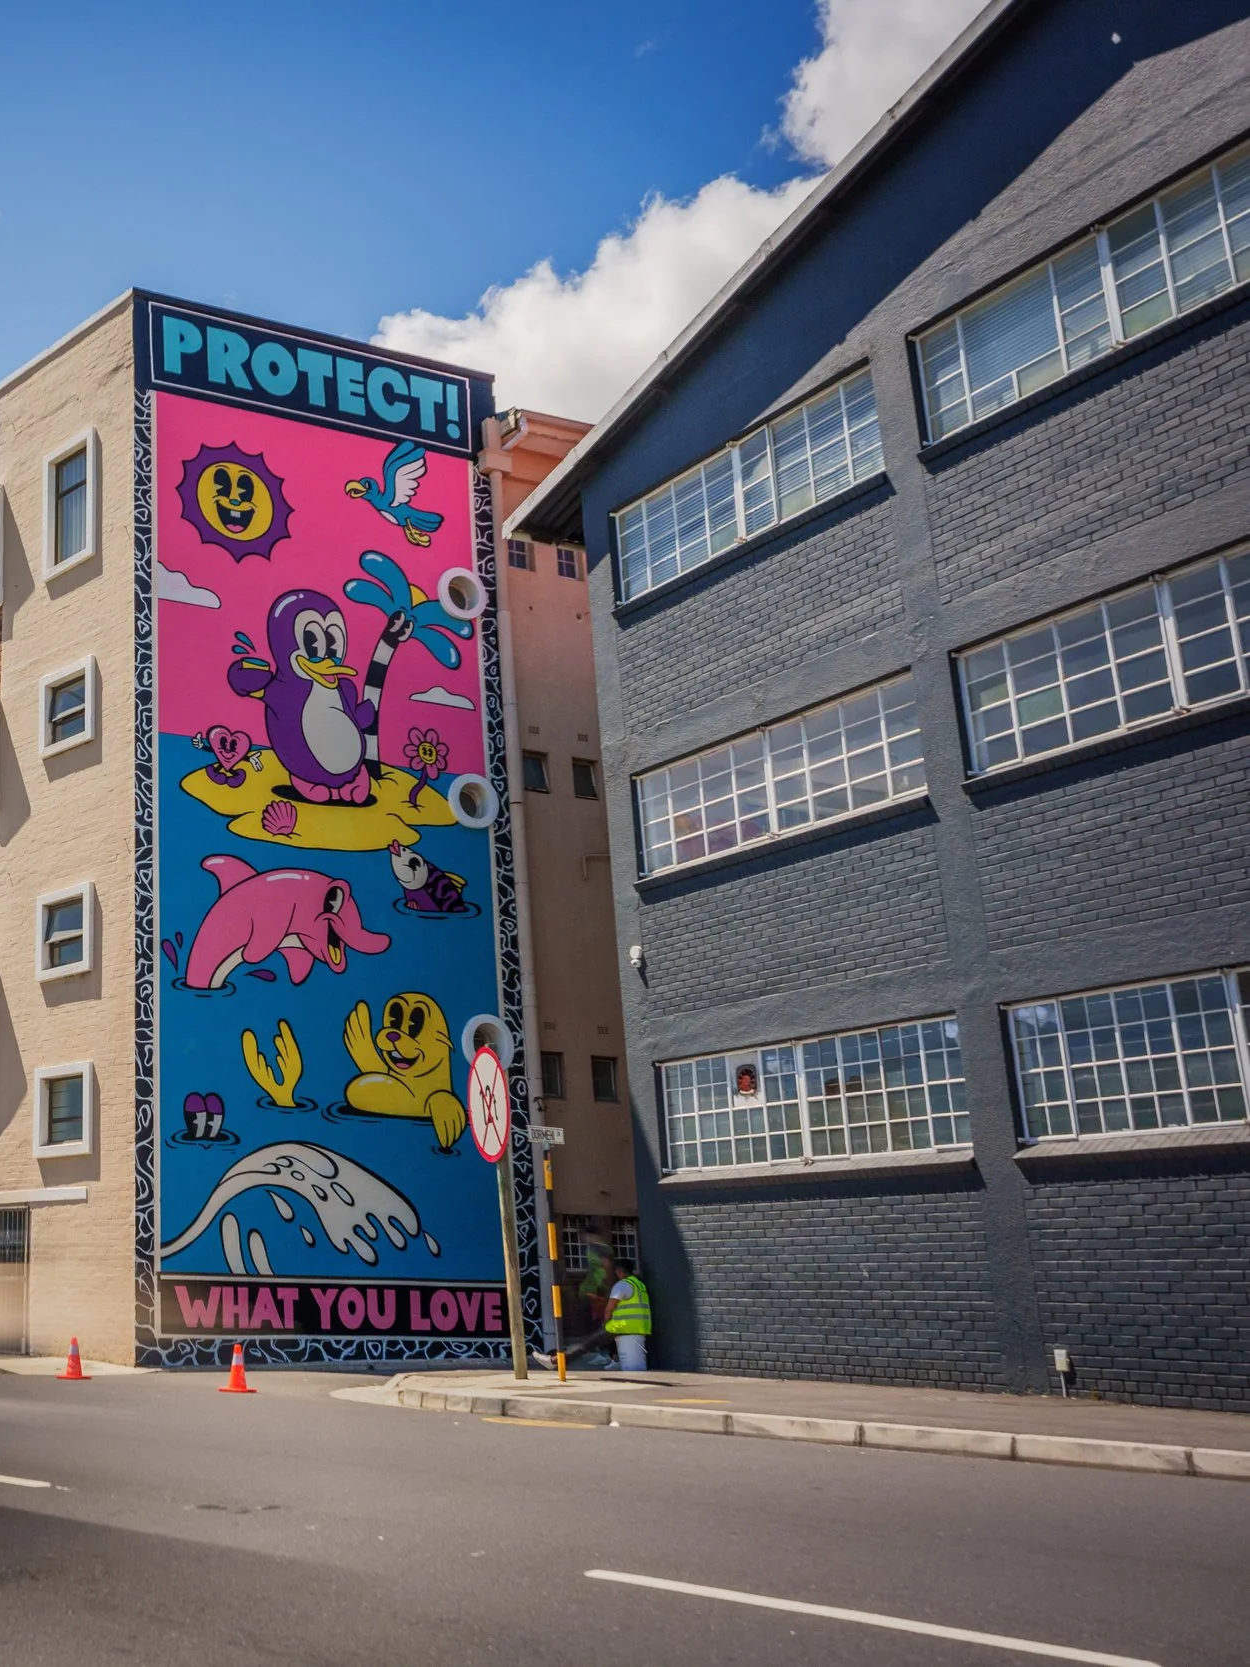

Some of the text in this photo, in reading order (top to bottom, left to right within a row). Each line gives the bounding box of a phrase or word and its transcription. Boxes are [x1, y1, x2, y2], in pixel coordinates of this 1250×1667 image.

[162, 314, 461, 440] PROTECT!
[174, 1285, 503, 1332] WHAT YOU LOVE
